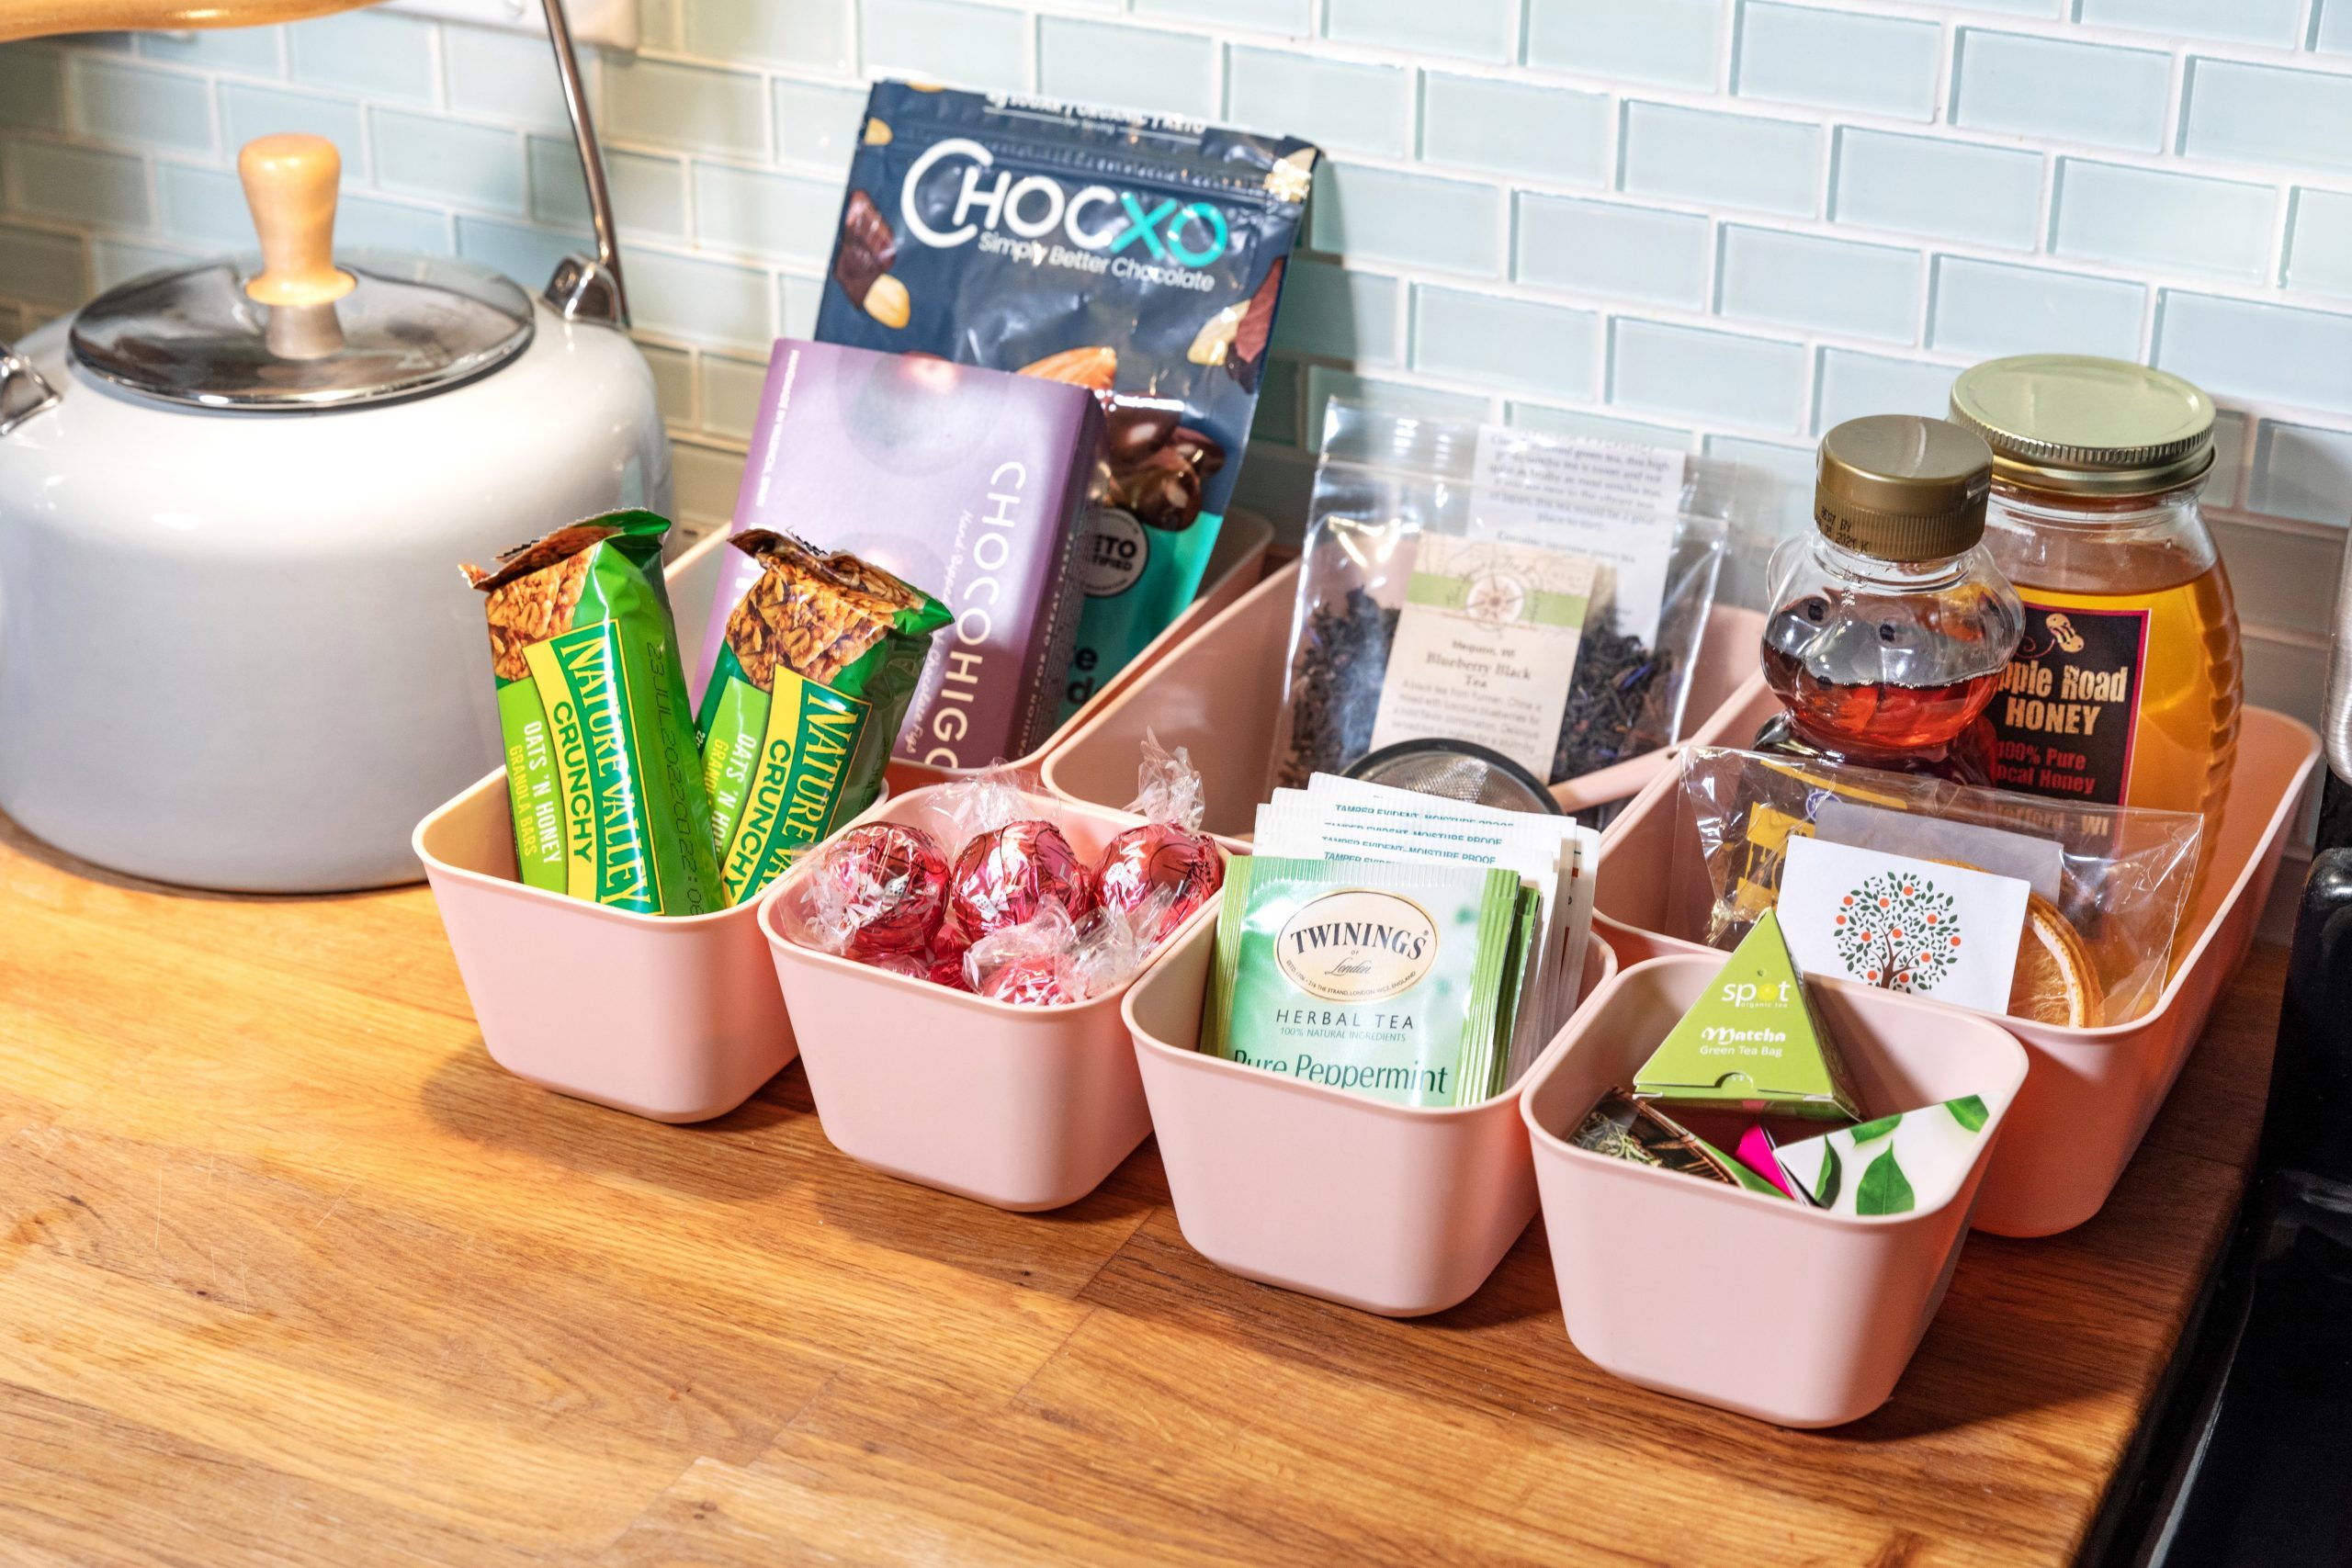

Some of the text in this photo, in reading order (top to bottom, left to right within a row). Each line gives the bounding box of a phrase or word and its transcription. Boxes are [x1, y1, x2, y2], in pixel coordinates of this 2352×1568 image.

[900, 138, 1229, 268] CHOCXO
[978, 231, 1216, 292] Simply Better Chocolate
[1425, 651, 1532, 680] Blueberry Black
[1464, 676, 1487, 687] Tea
[1997, 660, 2129, 704] pple Road
[2006, 696, 2101, 736] HONEY
[560, 636, 650, 904] NATURE VALLEY
[726, 733, 756, 784] OATS
[782, 693, 858, 844] NATURE
[1997, 740, 2086, 771] 100% Pure
[524, 721, 548, 771] OATS
[536, 800, 562, 863] HONEY
[553, 701, 593, 863] CRUNCHY
[1996, 764, 2095, 795] ocal Honey
[509, 743, 537, 857] GRANOLA BARS
[724, 739, 791, 897] CRUNCHY
[2082, 815, 2109, 837] WI
[1290, 922, 1428, 960] TWININGS
[1317, 984, 1327, 992] THE
[1391, 971, 1417, 989] ENGLAND
[1324, 957, 1373, 977] London
[1276, 1009, 1414, 1030] HERBAL TEA
[1281, 1027, 1407, 1043] 100% NATURAL INGREDIENTS
[1701, 1026, 1787, 1045] Matcha
[1700, 1045, 1783, 1058] Green Tea Bag
[1295, 1054, 1449, 1094] Peppermint
